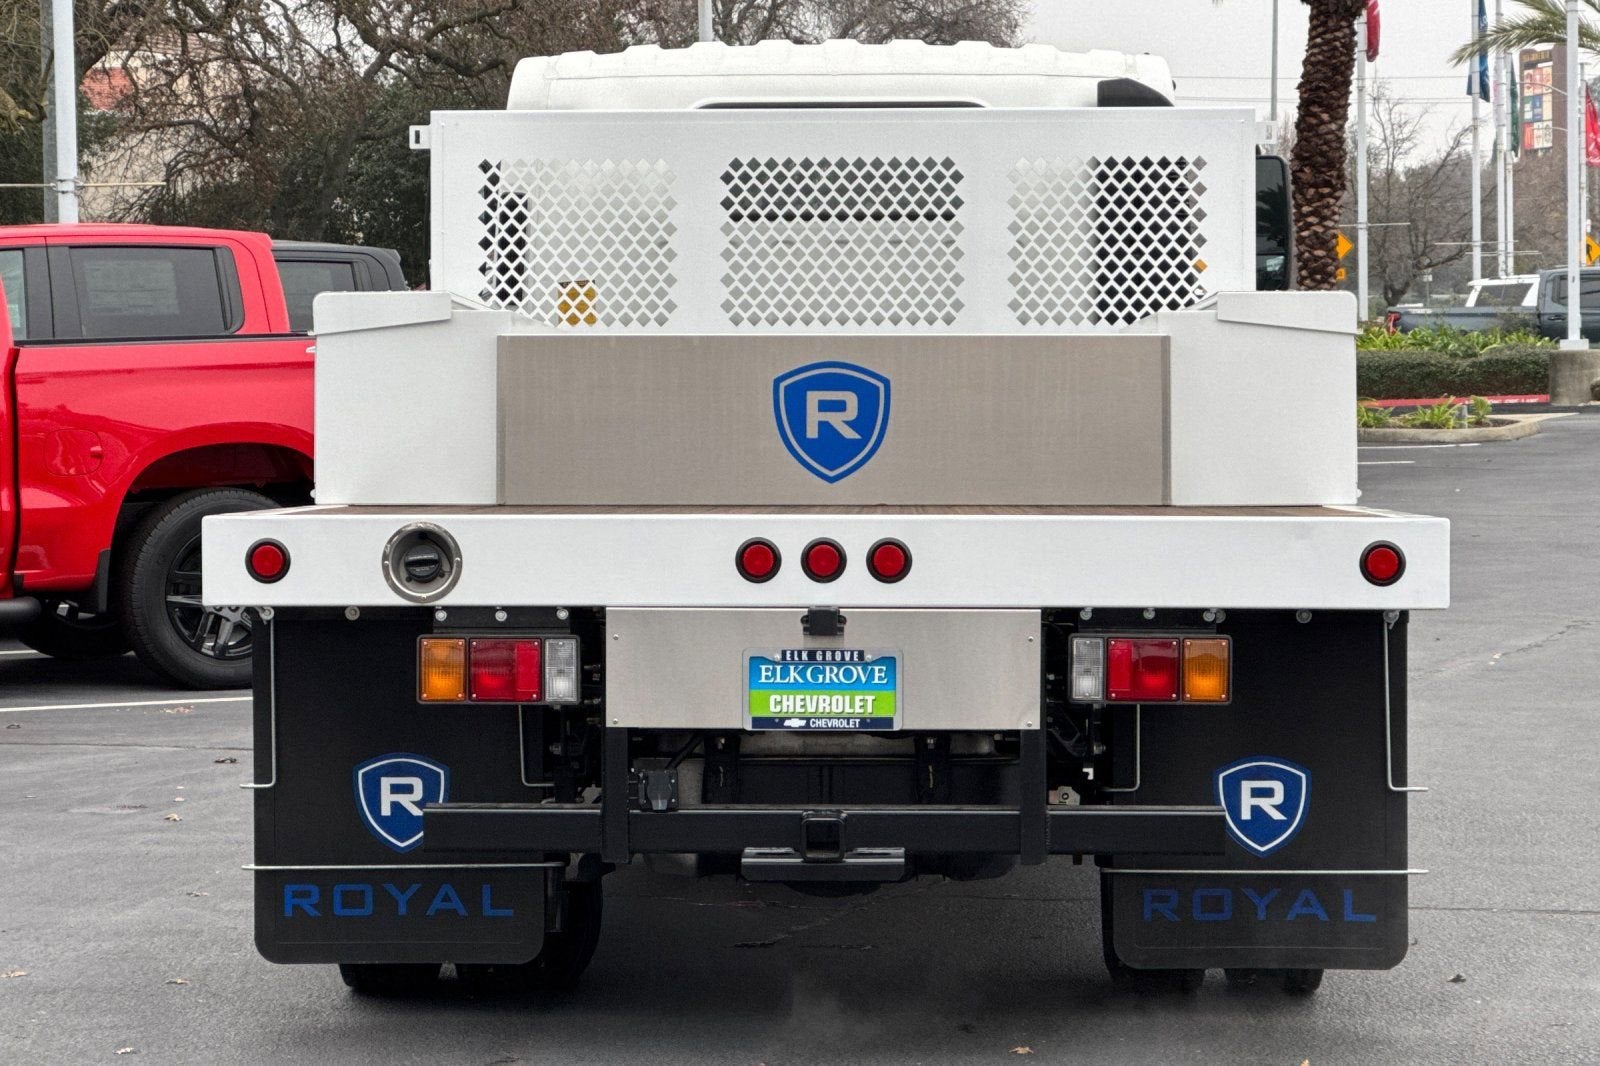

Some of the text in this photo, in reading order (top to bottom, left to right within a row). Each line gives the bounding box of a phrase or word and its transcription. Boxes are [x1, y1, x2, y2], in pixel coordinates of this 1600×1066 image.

[806, 390, 863, 439] R
[785, 650, 860, 662] ELK GROVE
[758, 665, 888, 684] ELK GROVE
[769, 694, 876, 714] CHEVROLET
[809, 718, 861, 728] CHEVROLET
[379, 776, 424, 816] R
[1240, 780, 1288, 821] R
[283, 883, 514, 917] ROYAL
[1142, 887, 1378, 922] ROYAL
